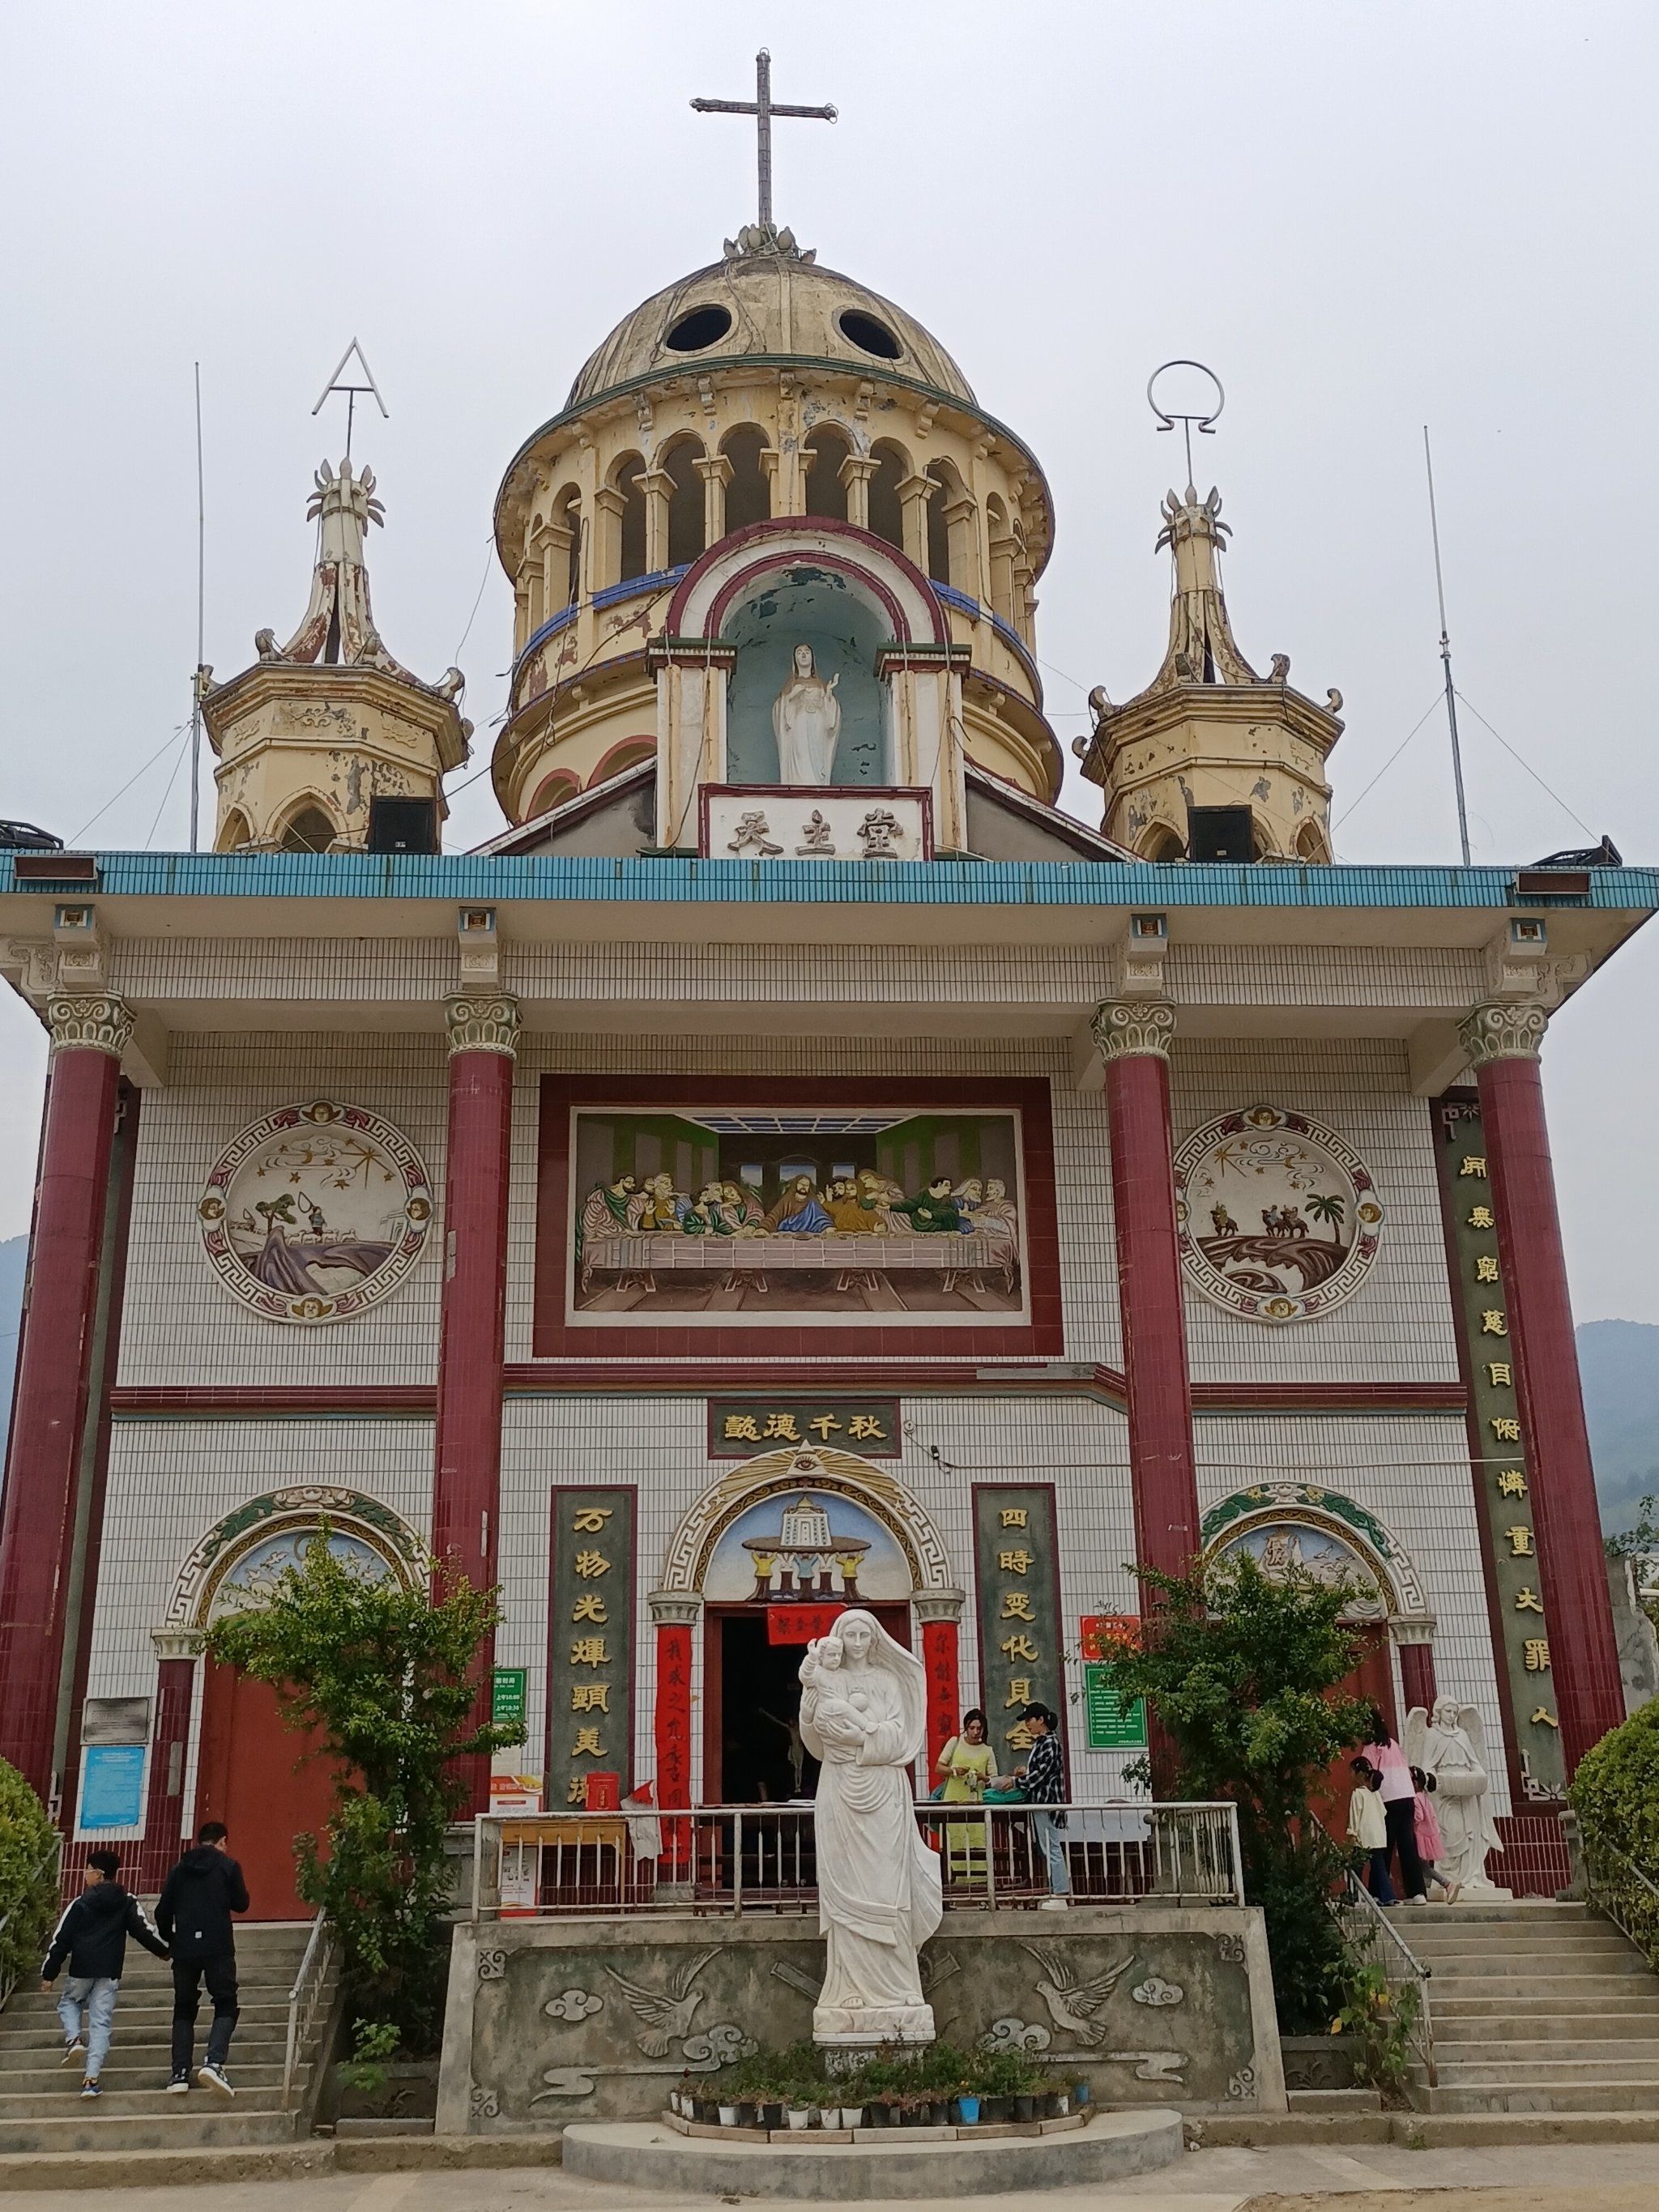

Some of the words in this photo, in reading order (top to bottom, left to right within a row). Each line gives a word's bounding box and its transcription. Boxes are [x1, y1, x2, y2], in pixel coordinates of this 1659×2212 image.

[727, 808, 903, 859] 天主堂
[724, 1413, 888, 1442] 懿德千秋
